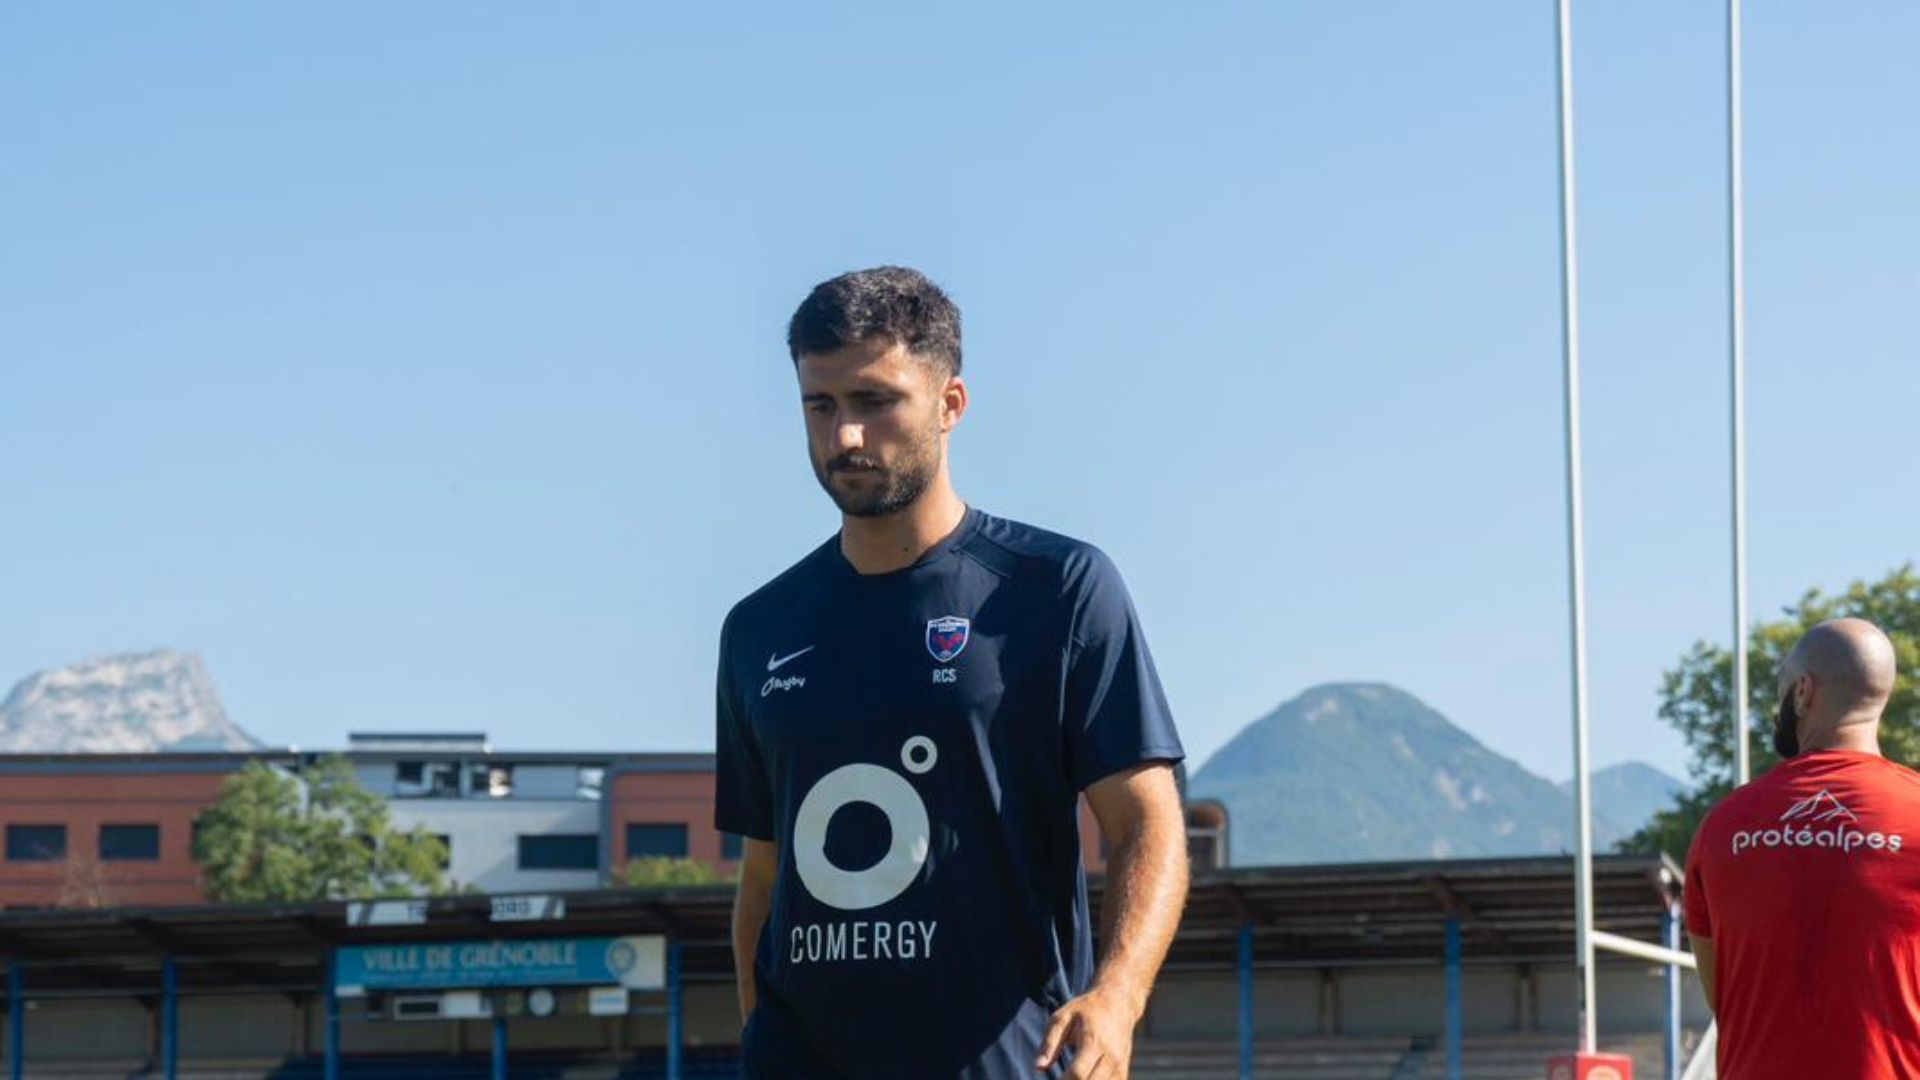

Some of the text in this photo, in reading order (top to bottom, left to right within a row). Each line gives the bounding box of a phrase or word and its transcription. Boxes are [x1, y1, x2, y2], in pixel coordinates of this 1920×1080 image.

[932, 668, 957, 684] RCS
[1732, 824, 1902, 855] protéalpes
[790, 920, 938, 963] COMERGY
[361, 947, 418, 970] VILLE
[426, 946, 452, 969] DE
